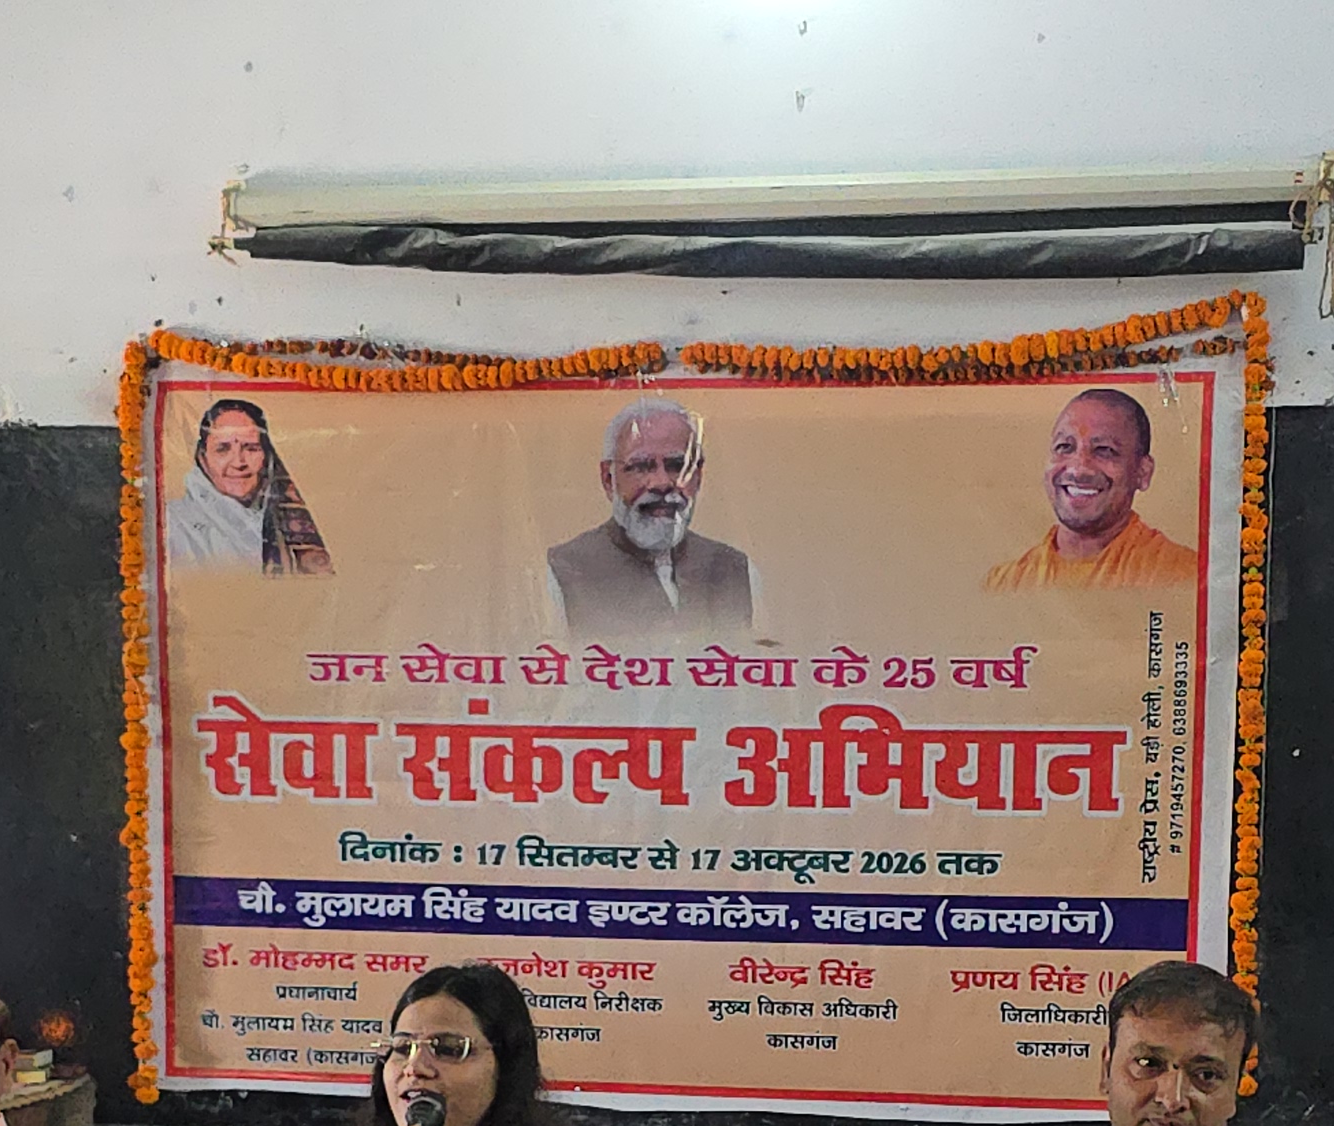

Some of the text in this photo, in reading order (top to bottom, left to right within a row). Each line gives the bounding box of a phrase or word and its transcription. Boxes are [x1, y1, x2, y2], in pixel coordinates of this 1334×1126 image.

[1144, 610, 1164, 679] कासगंज
[306, 643, 1039, 691] जन सेवा से देश सेवा के 25 वर्ष
[1141, 685, 1165, 730] होली,
[195, 694, 1128, 814] सेवा संकल्प अभियान
[337, 832, 443, 864] दिनांक
[476, 843, 508, 867] 17
[515, 835, 641, 871] सितम्बर
[647, 838, 679, 872] से
[690, 847, 721, 872] 17
[729, 848, 851, 886] अक्टूबर
[860, 850, 927, 876] 2026
[936, 851, 1003, 878] तक
[295, 891, 416, 927] मुलायम
[422, 887, 488, 922] सिंह
[495, 898, 581, 924] यादव
[588, 899, 669, 928] इण्टर
[675, 896, 800, 931] कॉलेज,
[811, 904, 926, 933] सहावर
[934, 897, 1115, 943] (कासगंज)
[202, 942, 429, 974] डॉ. मोहम्मद समर
[475, 951, 658, 989] जनेश कुमार
[727, 956, 876, 989] वीरेन्द्र सिंह
[950, 969, 1020, 993] प्रणय
[1029, 963, 1090, 995] सिंह
[593, 989, 664, 1013] निरीक्षक
[707, 995, 899, 1021] मुख्य विकास अधिकारी
[1000, 1001, 1109, 1026] जिलाधिकारी
[230, 1014, 295, 1036] मुलायम
[301, 1012, 334, 1033] सिंह
[341, 1018, 383, 1034] यादव
[245, 1045, 379, 1067] सहावर (कासगंज
[765, 1030, 839, 1051] कासगंज
[1015, 1038, 1091, 1059] कासगंज
